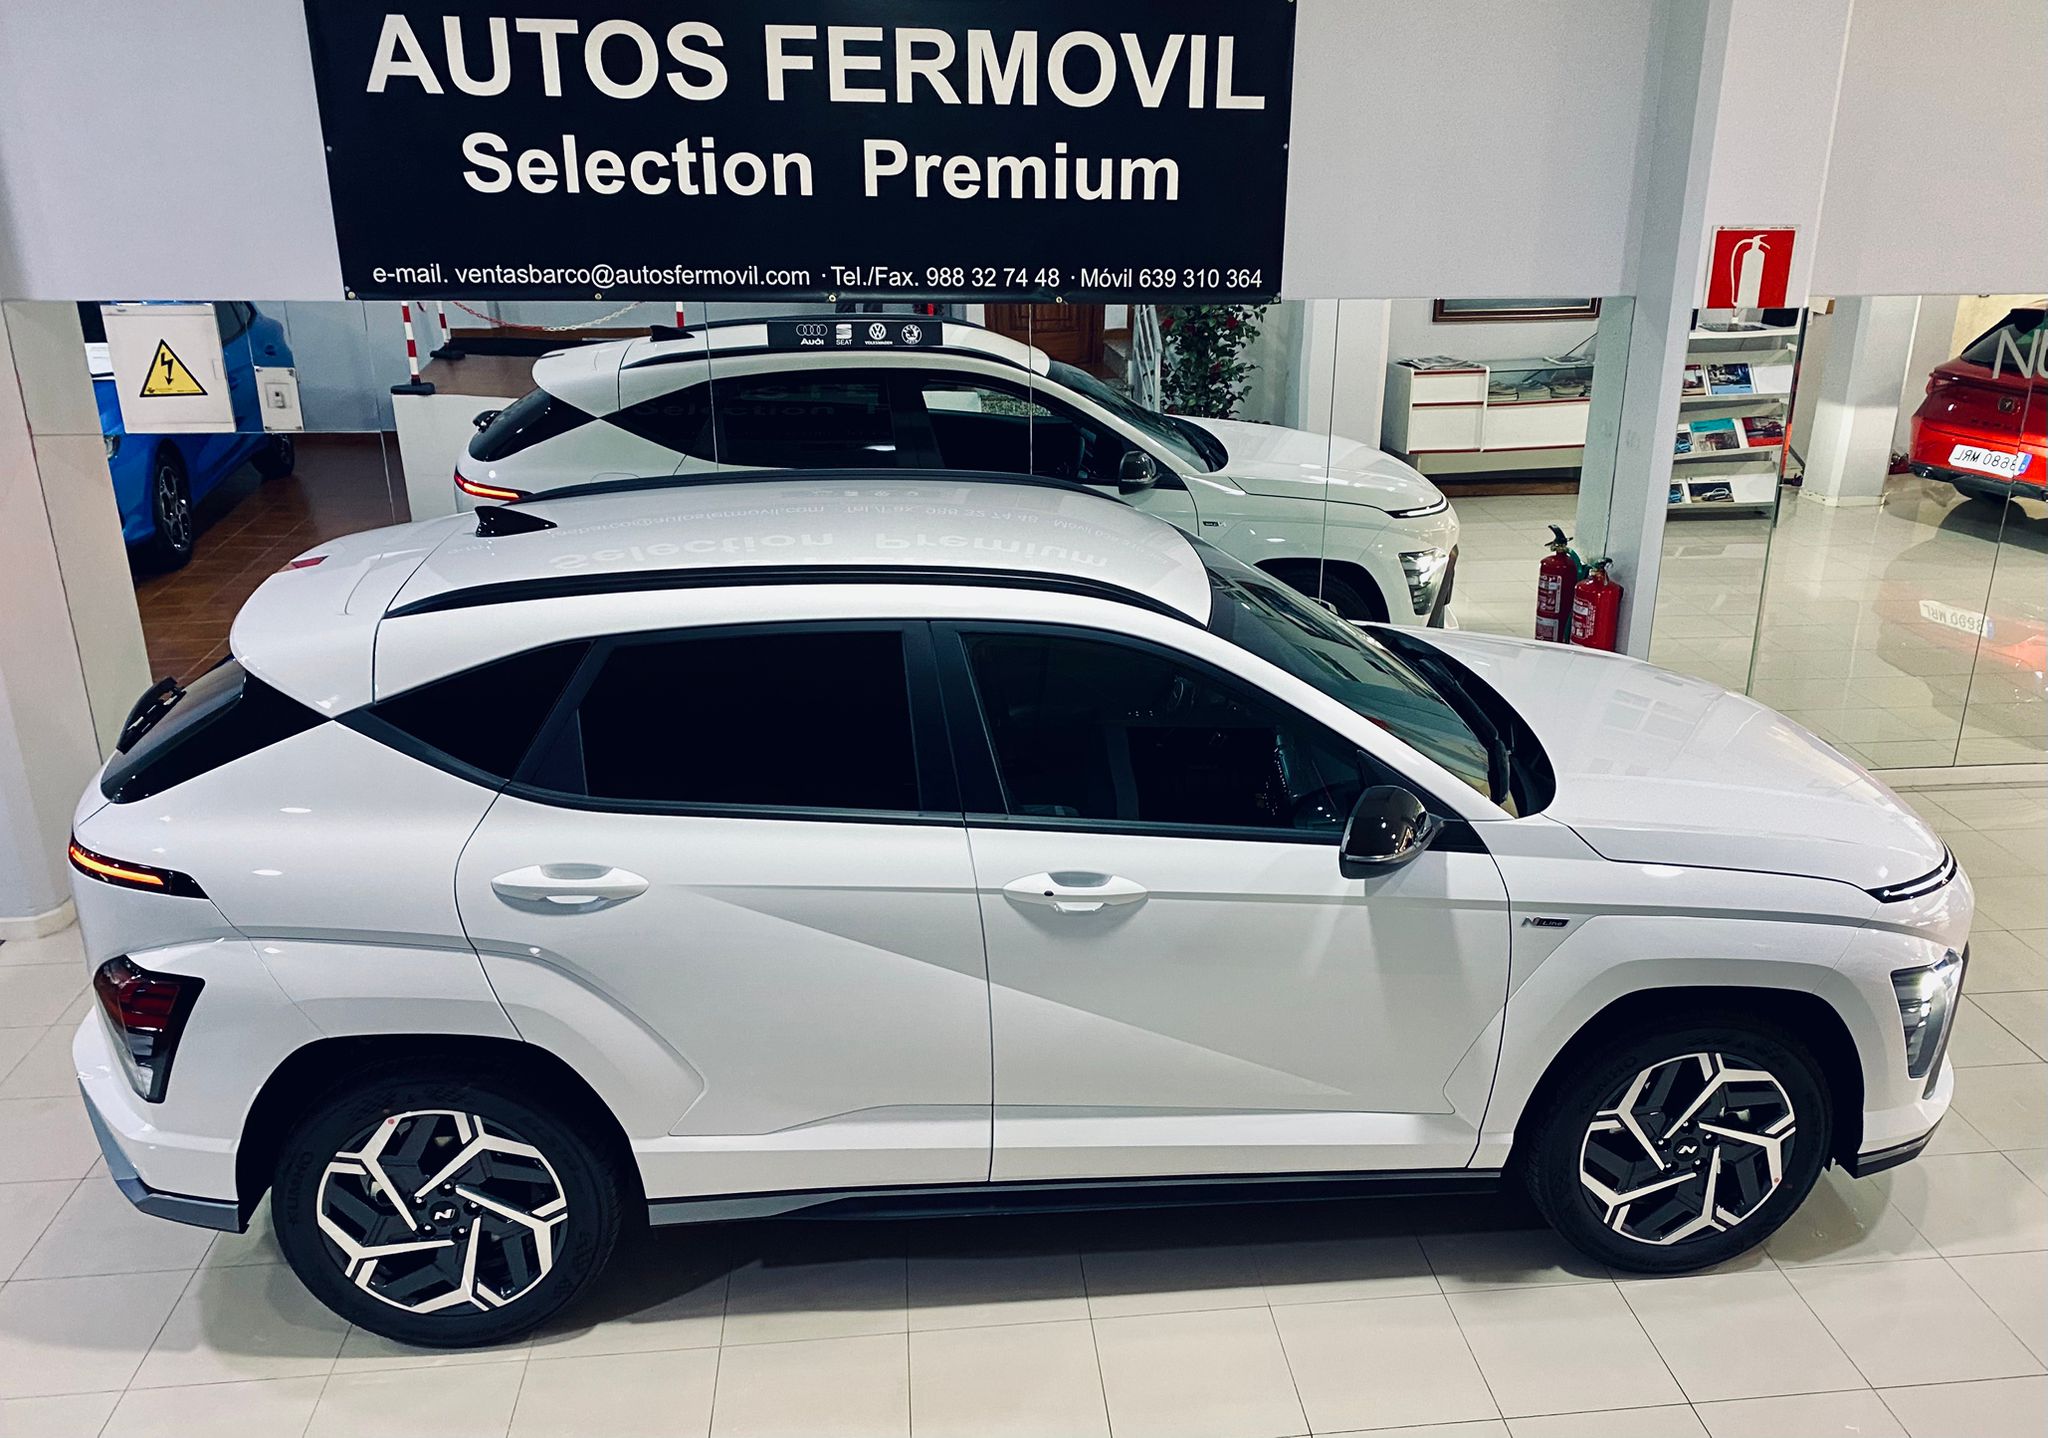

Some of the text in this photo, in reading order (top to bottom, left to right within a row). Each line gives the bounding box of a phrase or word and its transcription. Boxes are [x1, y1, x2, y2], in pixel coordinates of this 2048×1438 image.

[366, 13, 1266, 110] AUTOS FERMOVIL
[462, 131, 1179, 201] Selection Premium
[372, 263, 449, 284] e-mail.
[454, 263, 810, 289] ventasbarco@autosfermovil.com
[926, 266, 965, 287] 988
[971, 267, 997, 287] 32
[1003, 267, 1029, 288] 74
[1034, 267, 1060, 288] 48
[1139, 268, 1177, 288] 639
[1182, 268, 1220, 289] 310
[1226, 268, 1263, 288] 364
[1677, 1144, 1699, 1155] N
[433, 1208, 456, 1221] N
